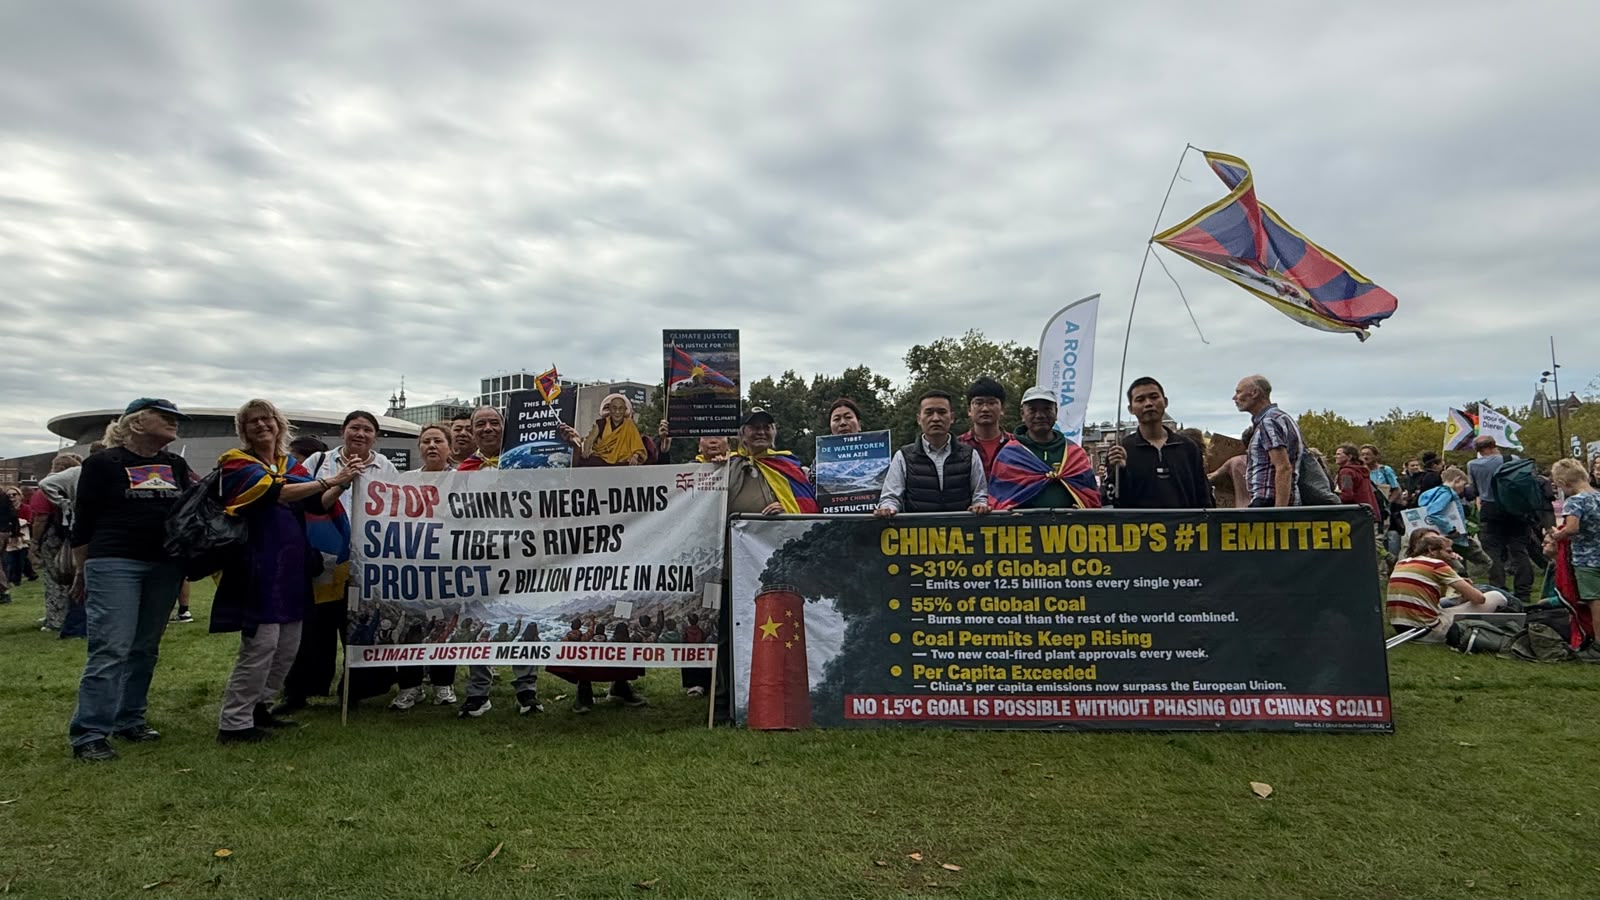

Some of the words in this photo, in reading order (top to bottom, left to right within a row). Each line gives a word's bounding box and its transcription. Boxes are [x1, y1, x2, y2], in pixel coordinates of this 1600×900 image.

[1065, 320, 1080, 334] A
[1052, 360, 1060, 394] NEDERL
[1060, 339, 1079, 406] ROCHA
[518, 408, 562, 420] PLANET
[520, 430, 556, 442] HOME
[834, 442, 885, 452] WATERTOREN
[364, 480, 440, 518] STOP
[448, 490, 532, 519] CHINA'S
[540, 485, 668, 518] MEGA-DAMS
[823, 504, 880, 514] DESTRUCTIEV
[364, 520, 443, 560] SAVE
[451, 529, 537, 561] TIBET'S
[543, 523, 625, 555] RIVERS
[880, 526, 974, 556] CHINA:
[980, 526, 1033, 554] THE
[1039, 523, 1167, 553] WORLD'S
[1174, 522, 1209, 552] #1
[1221, 521, 1352, 550] EMITTER
[910, 560, 967, 577] >31%
[972, 560, 994, 576] of
[997, 559, 1067, 576] Global
[363, 563, 492, 600] PROTECT
[498, 571, 510, 595] 2
[515, 567, 569, 594] BILLION
[574, 565, 627, 592] PEOPLE
[633, 565, 651, 591] IN
[655, 564, 694, 592] ASIA
[926, 579, 960, 590] Emits
[963, 581, 991, 590] over
[994, 580, 1019, 589] 12.5
[1022, 578, 1062, 589] billion
[1065, 579, 1093, 588] tons
[1096, 579, 1130, 590] every
[1133, 577, 1170, 590] single
[1172, 578, 1202, 590] year.
[911, 597, 952, 612] 55%
[957, 596, 976, 612] of
[980, 596, 1041, 612] Global
[1044, 596, 1086, 612] Coal
[927, 615, 962, 625] Burns
[965, 616, 995, 625] more
[997, 614, 1022, 624] coal
[1025, 614, 1052, 624] than
[1055, 614, 1074, 624] the
[1077, 614, 1101, 624] rest
[1104, 613, 1116, 624] of
[1118, 613, 1138, 624] the
[1141, 612, 1175, 623] world
[1178, 612, 1239, 622] combined.
[912, 631, 954, 646] Coal
[959, 630, 1033, 646] Permits
[1038, 630, 1086, 648] Keep
[1092, 630, 1152, 648] Rising
[363, 647, 425, 662] CLIMATE
[429, 646, 490, 660] JUSTICE
[495, 646, 551, 660] MEANS
[556, 646, 626, 661] JUSTICE
[632, 647, 665, 662] FOR
[671, 647, 714, 662] TIBET
[931, 650, 954, 660] Two
[957, 652, 982, 660] new
[985, 650, 1042, 660] coal-fired
[1044, 649, 1077, 662] plant
[1080, 649, 1137, 662] approvals
[1140, 650, 1172, 660] every
[1175, 648, 1208, 658] week.
[913, 664, 943, 680] Per
[948, 664, 1006, 682] Capita
[1012, 664, 1096, 680] Exceeded
[930, 682, 972, 692] China's
[976, 684, 994, 694] per
[998, 682, 1032, 694] capita
[1036, 682, 1092, 692] emissions
[1096, 684, 1119, 692] now
[1122, 682, 1168, 693] surpass
[1171, 682, 1190, 691] the
[1193, 681, 1246, 693] European
[1250, 680, 1286, 691] Union.
[853, 698, 876, 715] NO
[928, 698, 968, 716] GOAL
[974, 700, 990, 716] IS
[994, 700, 1070, 717] POSSIBLE
[1074, 699, 1150, 717] WITHOUT
[1154, 698, 1226, 716] PHASING
[1230, 698, 1260, 716] OUT
[1265, 698, 1332, 716] CHINA'S
[1336, 699, 1382, 717] COAL!
